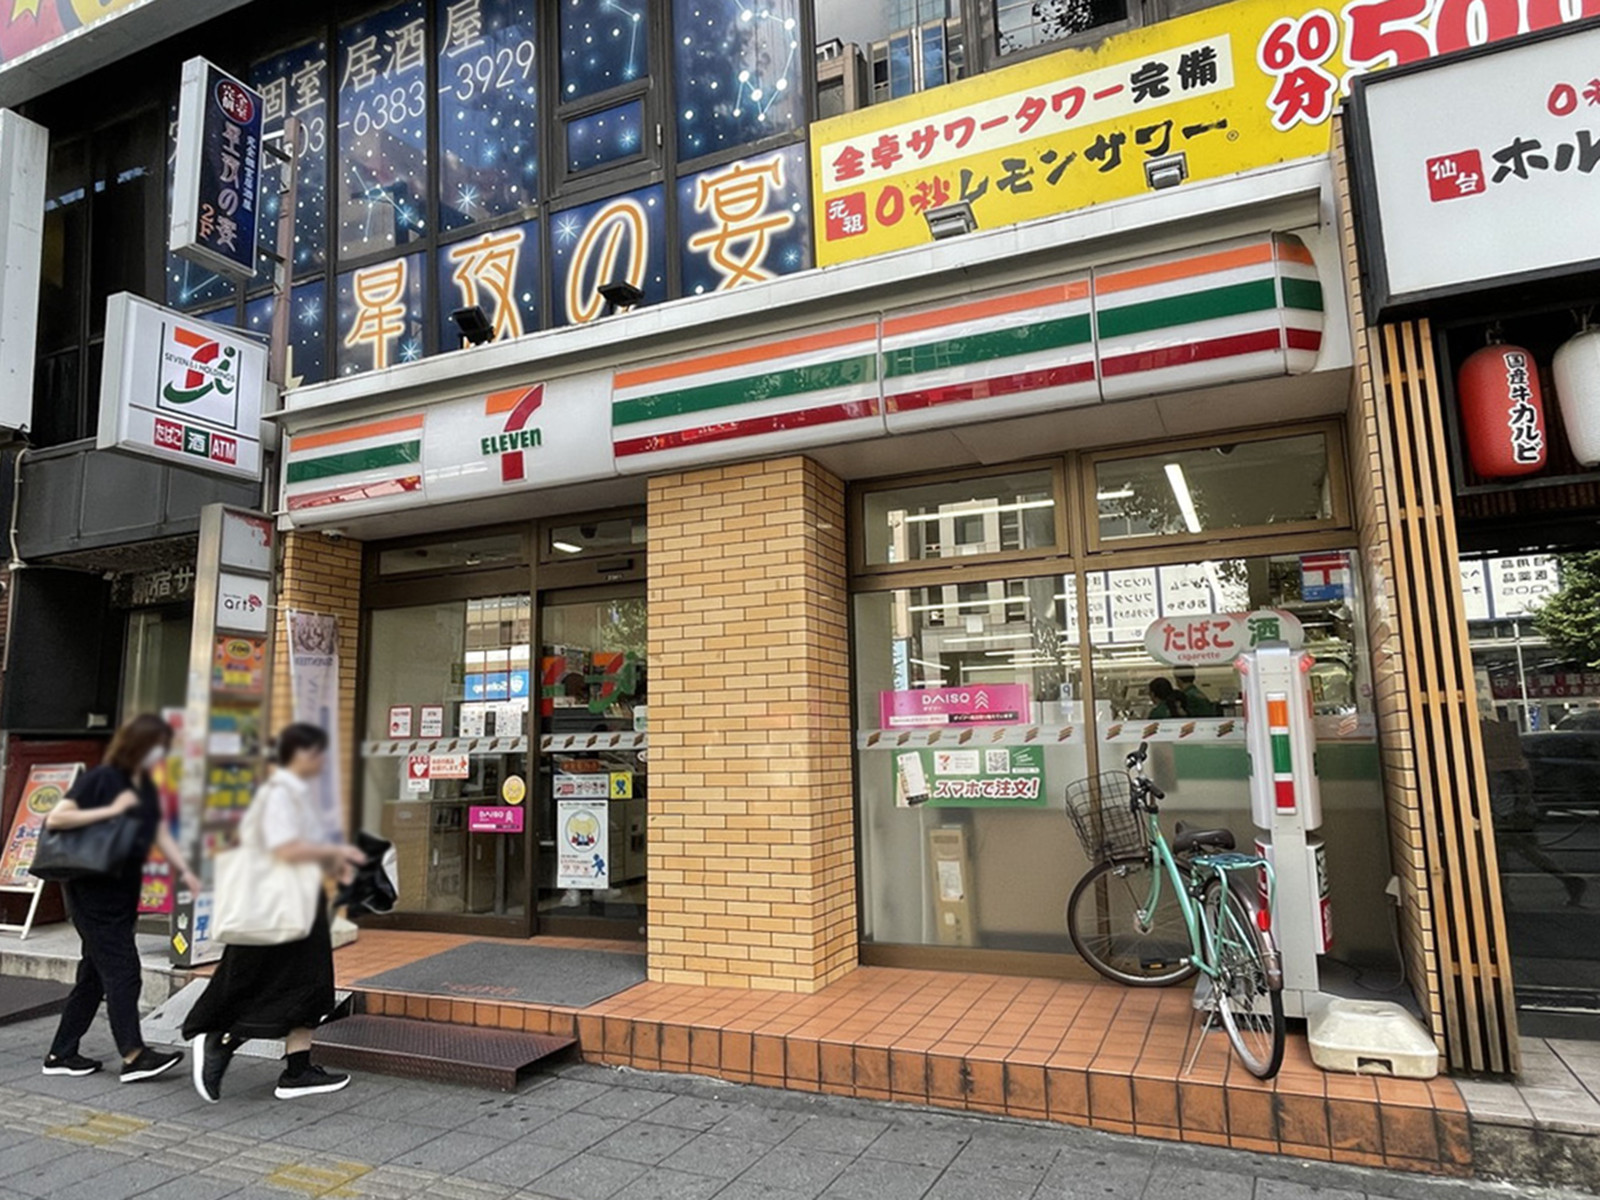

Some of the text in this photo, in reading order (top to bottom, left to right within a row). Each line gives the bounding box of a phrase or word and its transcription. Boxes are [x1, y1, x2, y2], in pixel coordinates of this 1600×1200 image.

[1262, 15, 1331, 70] 60
[1273, 66, 1331, 125] 分
[832, 46, 1218, 182] 全卓サワータワー完備
[1430, 159, 1480, 193] 仙台
[827, 199, 865, 234] 元祖
[345, 157, 790, 370] 星夜の宴
[1504, 352, 1541, 463] 国産牛カルビ
[156, 423, 236, 459] たばこ 酒 ATM
[1163, 617, 1280, 652] たばこ 酒
[922, 692, 970, 705] DAISO
[935, 777, 1041, 801] スマホで注文!
